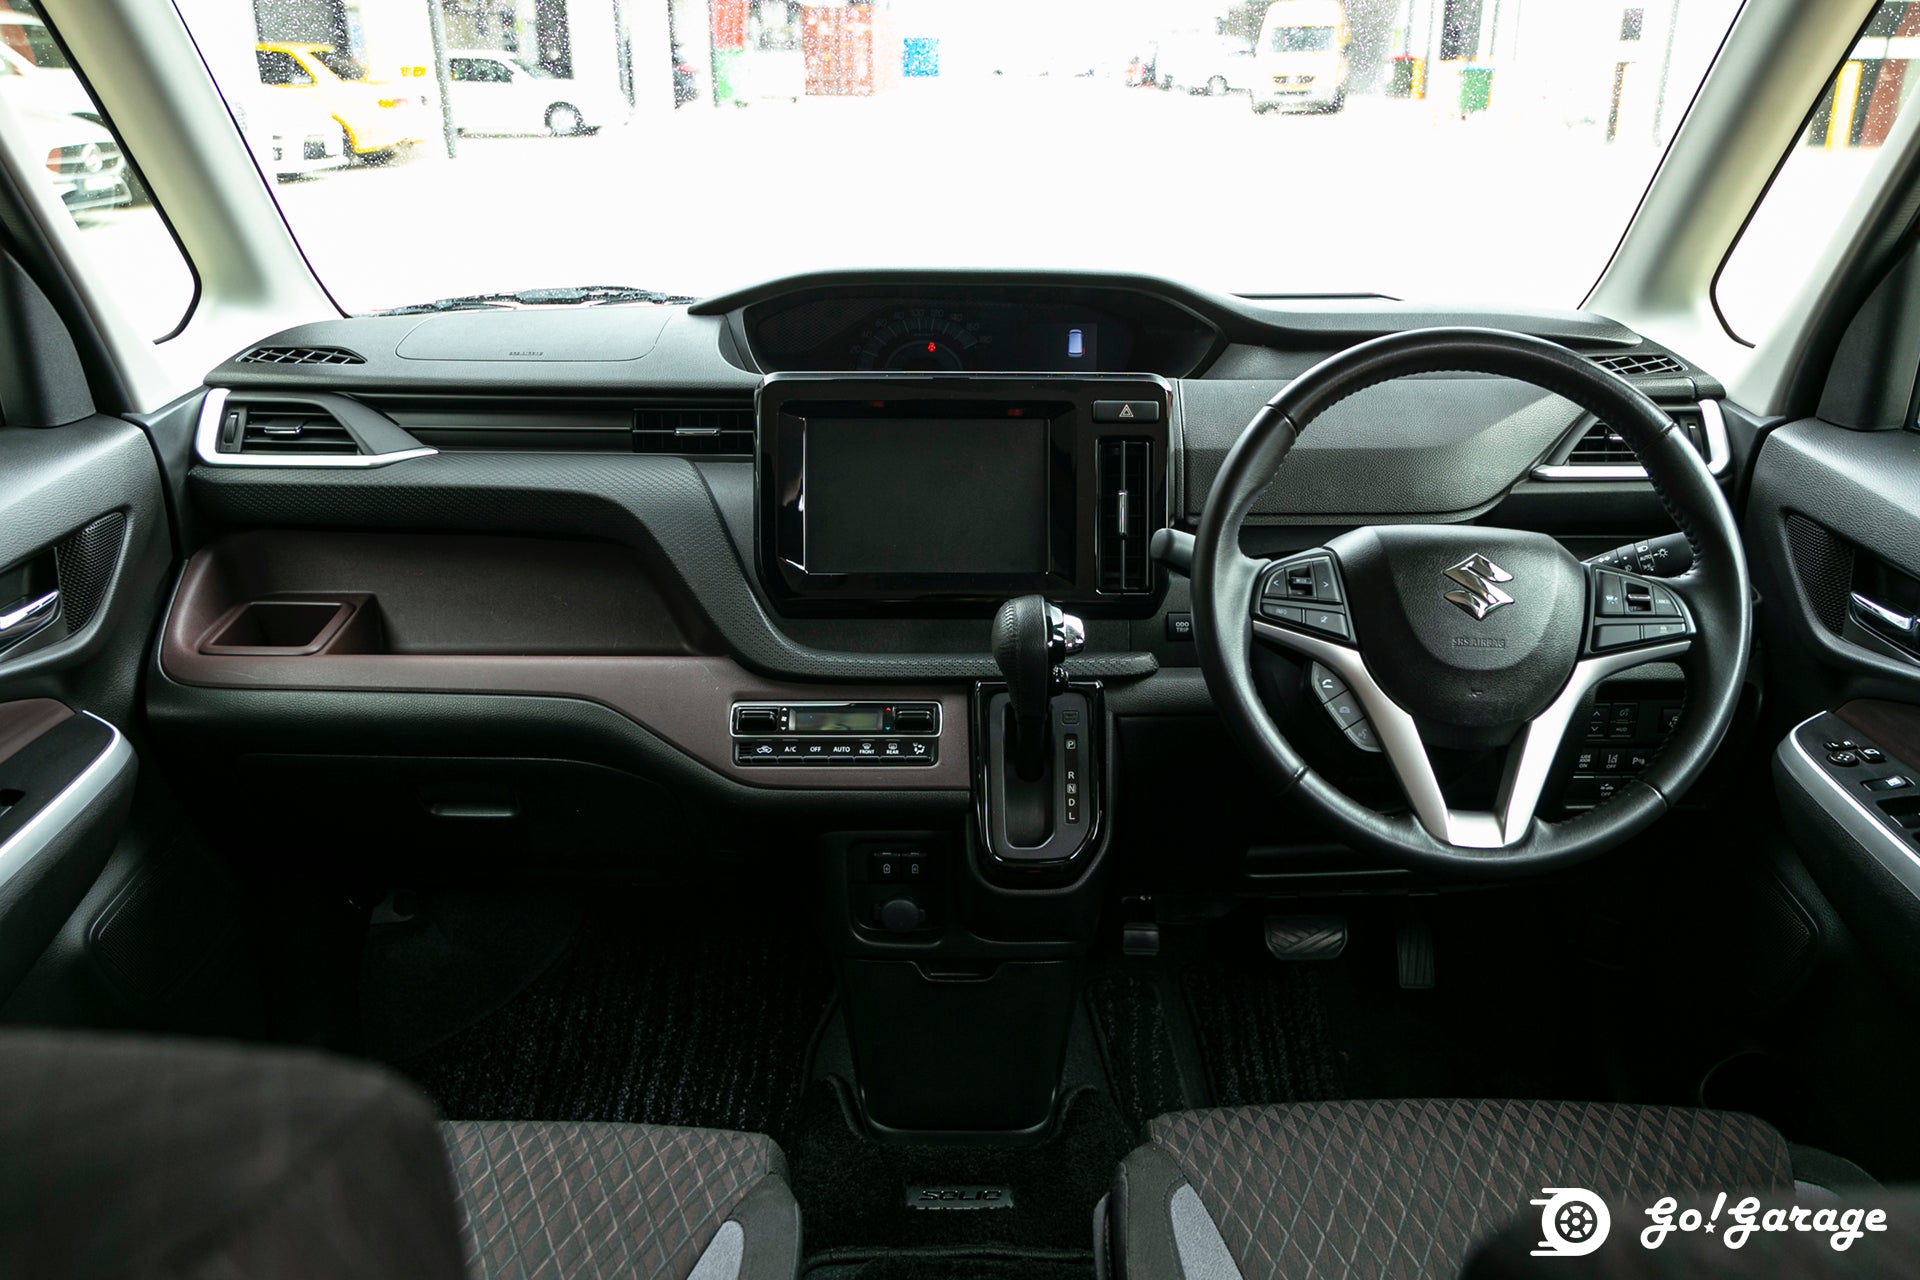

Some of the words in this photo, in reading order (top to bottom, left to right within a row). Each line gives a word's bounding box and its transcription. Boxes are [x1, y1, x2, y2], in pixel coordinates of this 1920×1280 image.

[1452, 637, 1470, 647] SRS
[1472, 637, 1506, 648] AIRBAG
[1067, 771, 1075, 780] R
[1068, 798, 1076, 807] D
[1068, 812, 1076, 820] L
